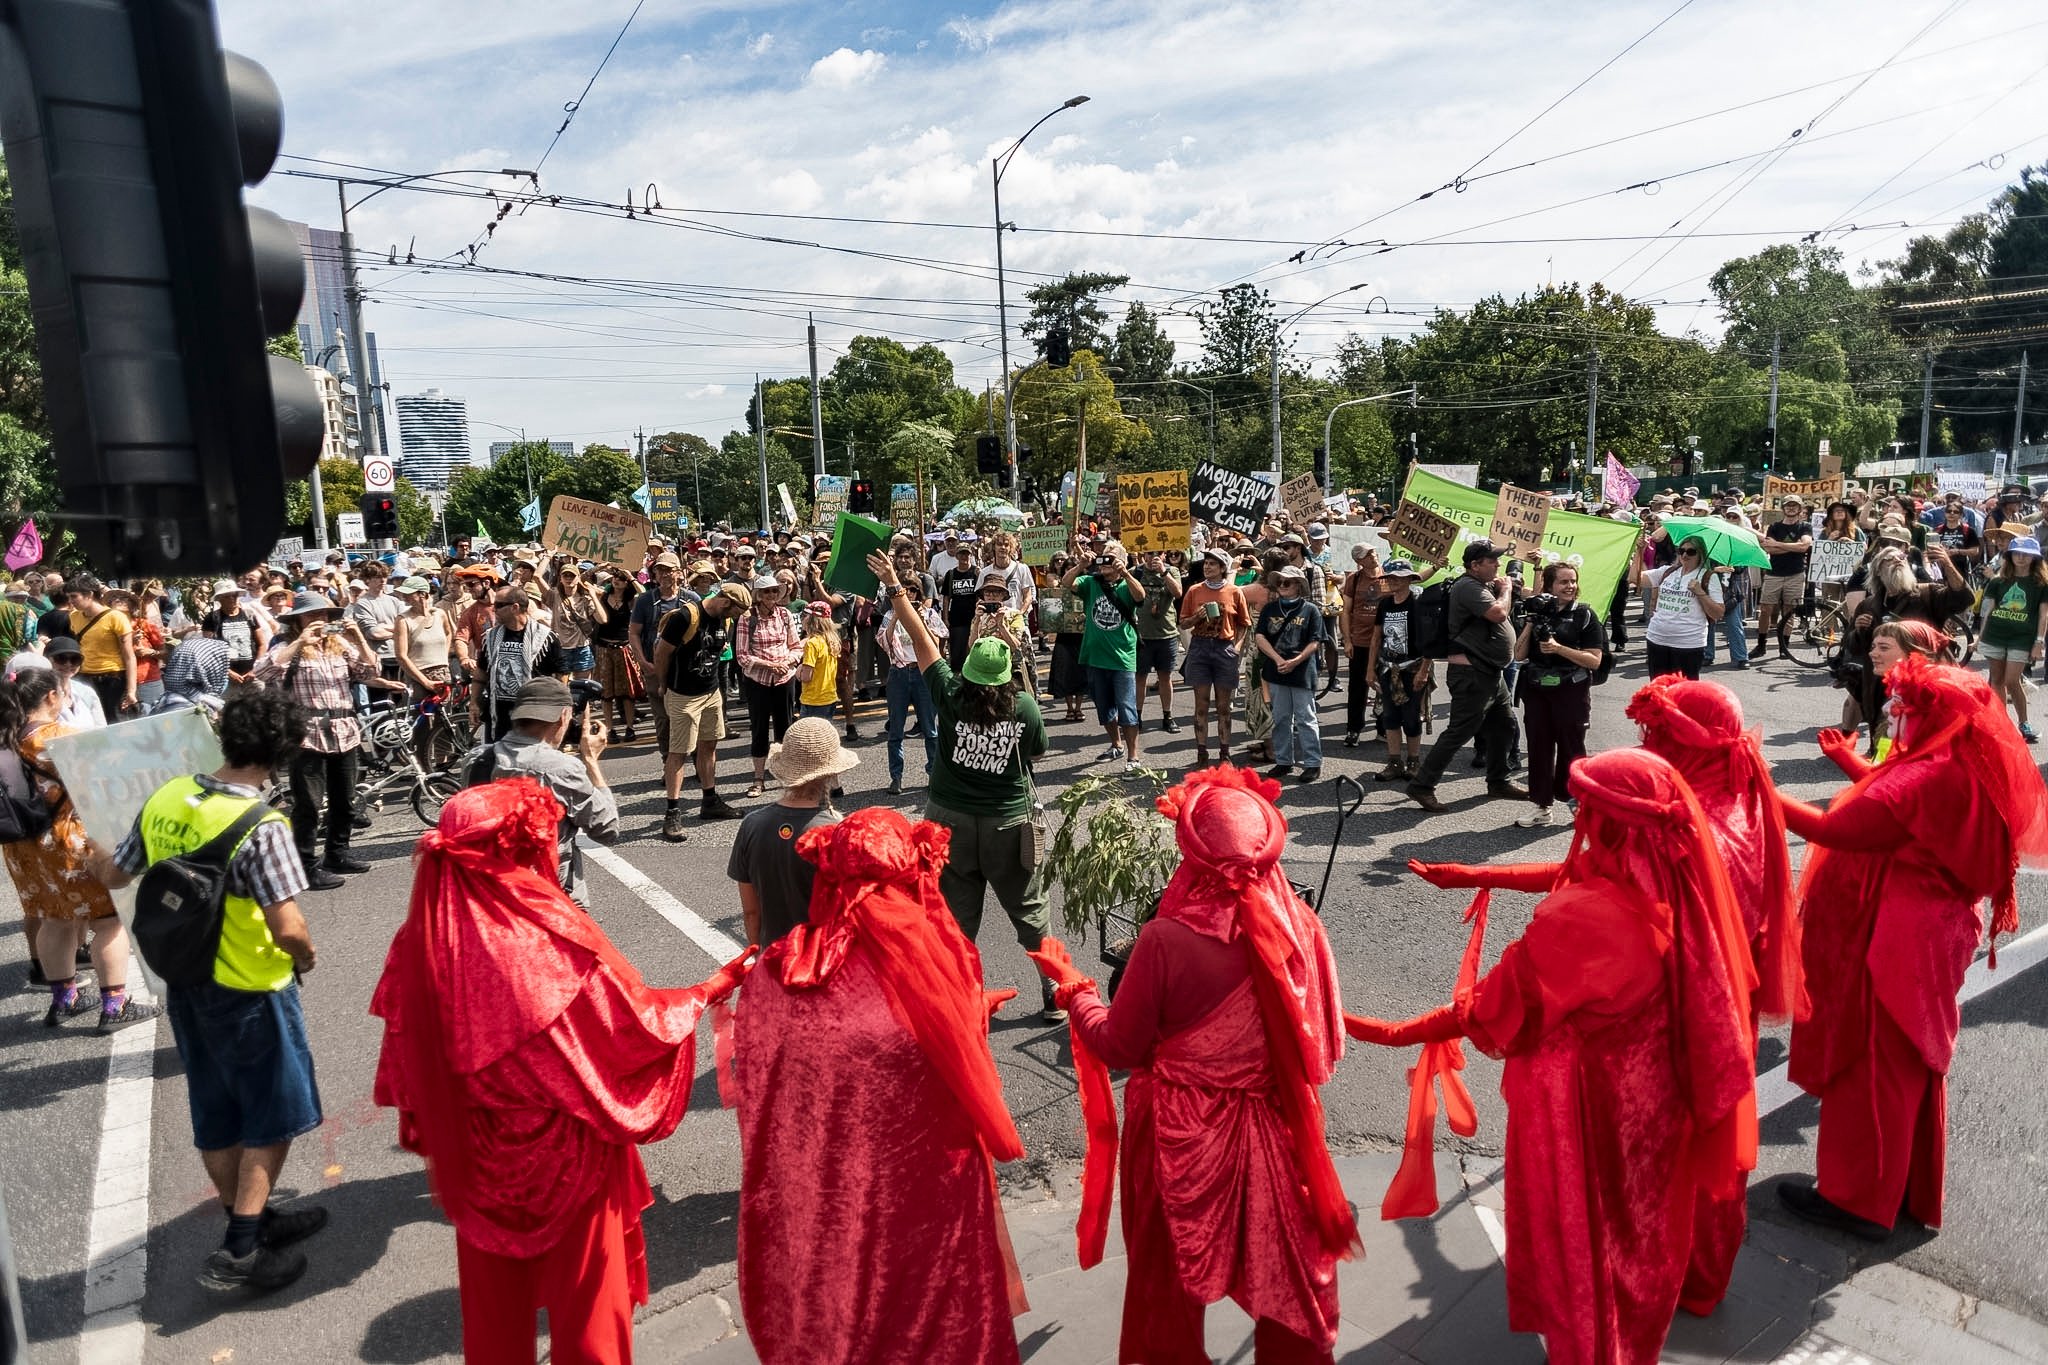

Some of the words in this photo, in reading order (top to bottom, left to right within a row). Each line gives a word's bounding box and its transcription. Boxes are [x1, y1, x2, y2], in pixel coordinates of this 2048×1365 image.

[371, 468, 388, 480] 60
[1197, 462, 1273, 501] MOUNTAIN
[650, 487, 677, 497] FORESTS
[1119, 482, 1141, 500] NO
[1286, 476, 1310, 496] STOP
[1286, 485, 1317, 504] BURNING
[1769, 480, 1839, 494] PROTECT
[656, 500, 673, 508] ARE
[1192, 491, 1231, 512] NOT
[1210, 483, 1255, 510] ASH!
[1299, 496, 1310, 505] MY
[1505, 488, 1546, 510] THERE
[561, 500, 588, 516] LEAVE
[590, 509, 617, 525] ALONE
[620, 516, 640, 529] OUR
[651, 511, 677, 521] HOMES
[820, 502, 842, 511] FORESTS
[1294, 501, 1324, 521] FUTURE
[1416, 494, 1440, 512] We
[1443, 505, 1471, 523] are
[1474, 515, 1485, 528] a
[1507, 506, 1519, 518] IS
[1523, 511, 1541, 524] NO
[1121, 508, 1145, 527] NO
[1215, 511, 1257, 536] CASH
[1401, 502, 1457, 540] FORESTS
[1021, 529, 1065, 540] BIODIVERSITY
[1393, 521, 1446, 559] FOREVER
[1495, 520, 1541, 544] PLANET
[556, 526, 625, 564] HOME
[1506, 542, 1517, 556] B
[1813, 541, 1864, 556] FORESTS
[952, 579, 975, 589] HEAL
[983, 721, 1026, 738] NATIVE
[957, 732, 1020, 759] FOREST
[952, 746, 1008, 775] LOGGING
